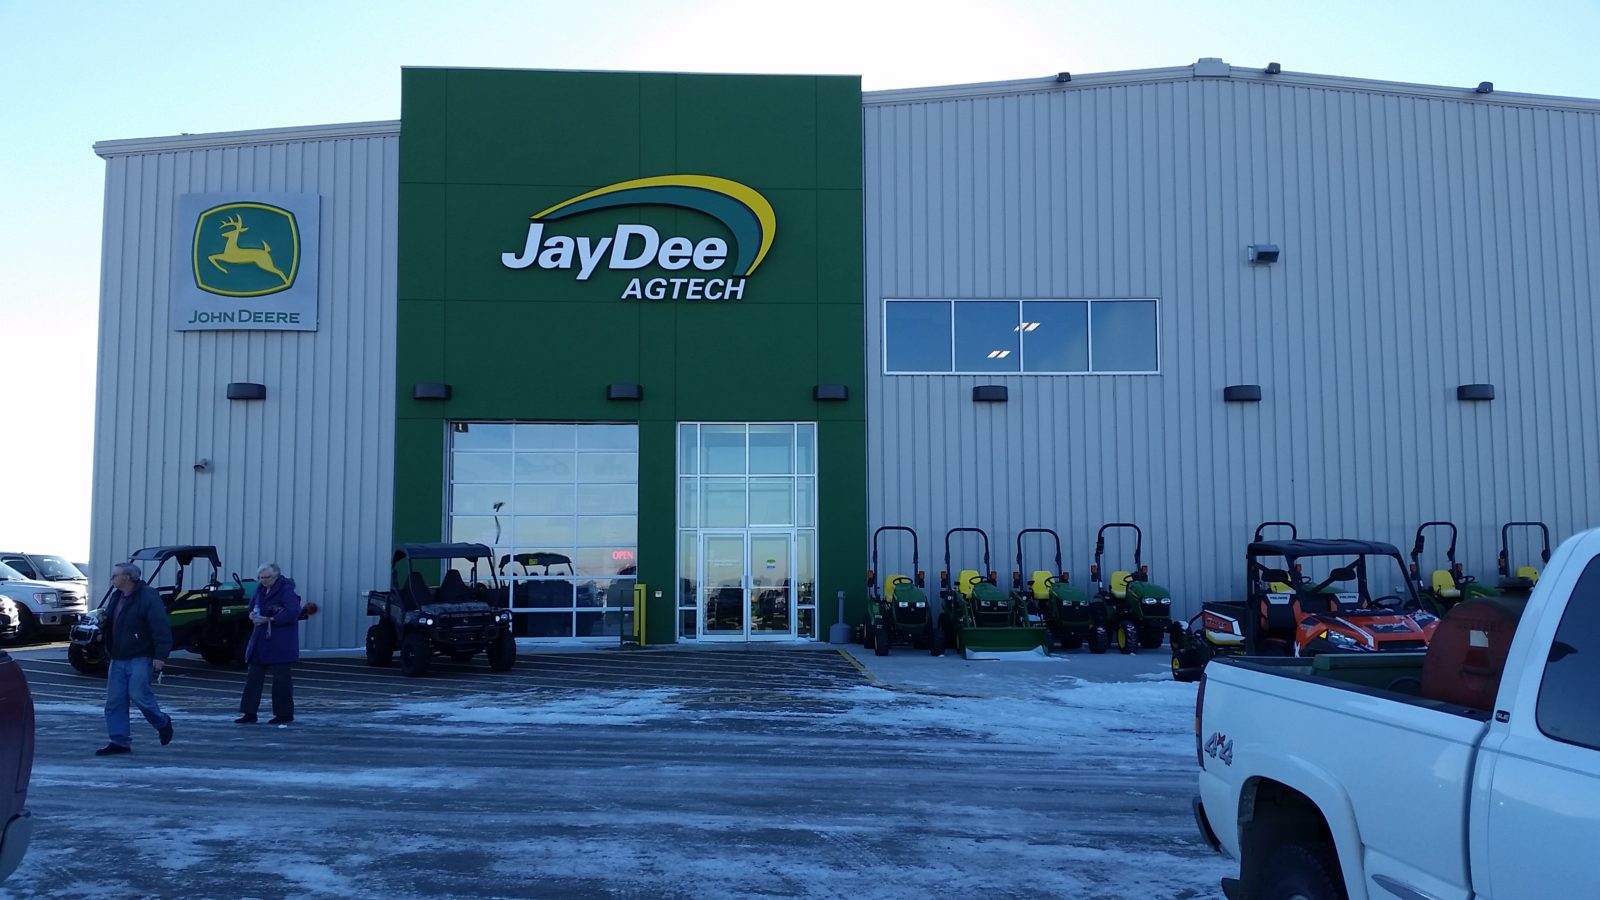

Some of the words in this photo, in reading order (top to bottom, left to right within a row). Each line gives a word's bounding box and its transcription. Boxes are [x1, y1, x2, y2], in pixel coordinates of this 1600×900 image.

[501, 223, 728, 281] JayDee
[621, 278, 747, 300] AGTECH
[188, 310, 236, 323] JOHN
[238, 309, 301, 323] DEERE
[612, 550, 634, 561] OPEN
